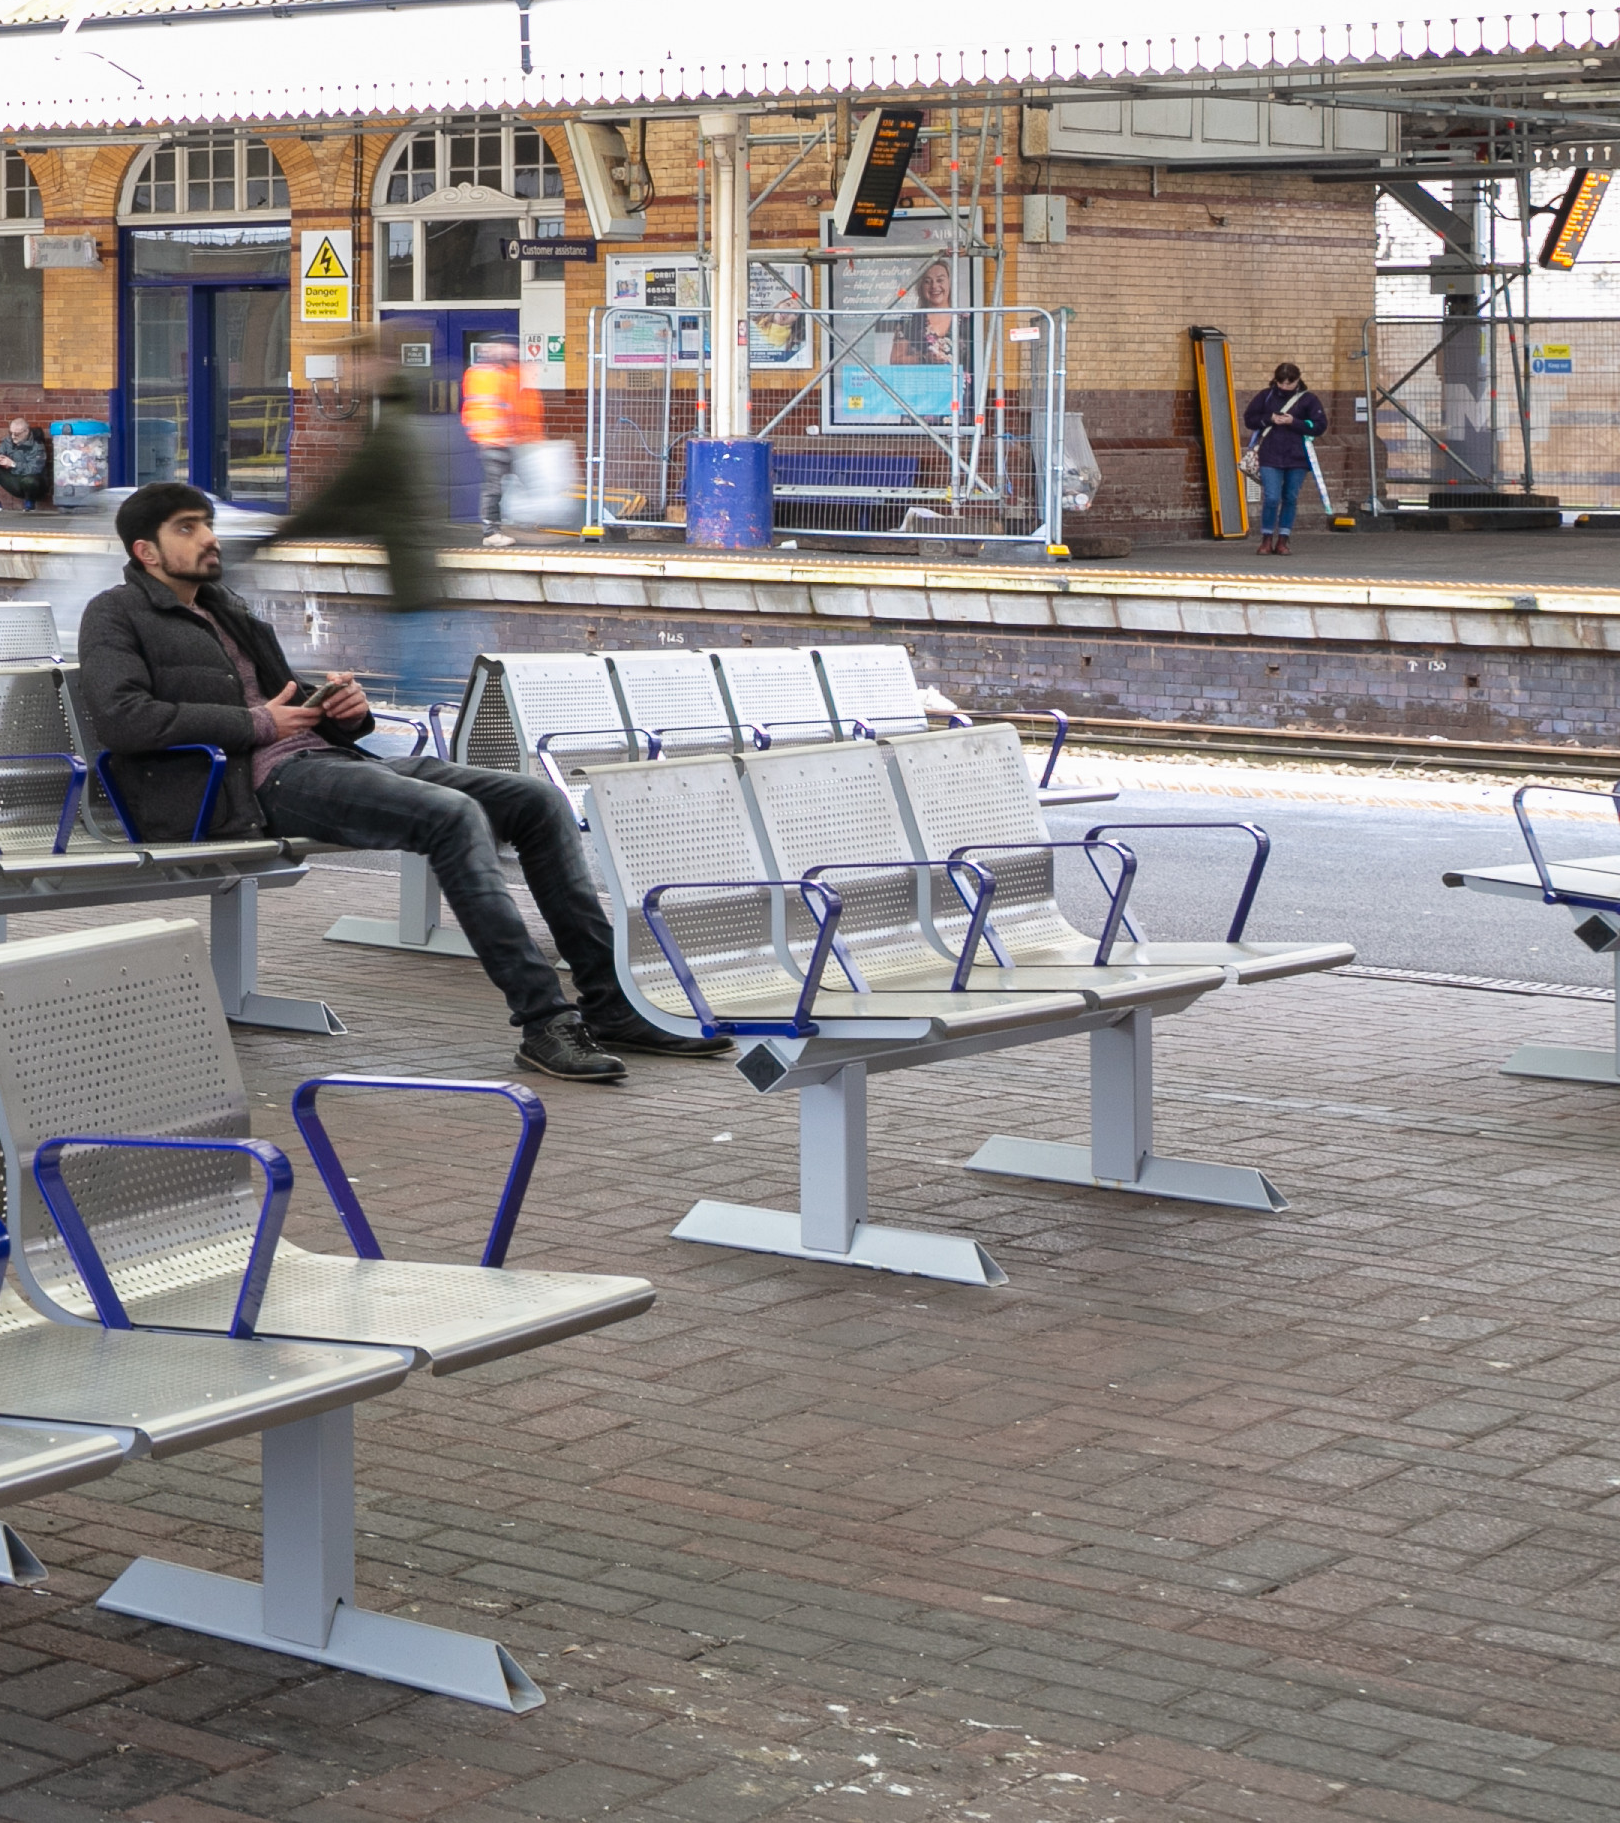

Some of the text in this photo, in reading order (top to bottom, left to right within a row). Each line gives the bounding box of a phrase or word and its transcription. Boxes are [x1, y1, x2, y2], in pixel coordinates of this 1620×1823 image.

[522, 244, 587, 256] Customer assistance
[881, 267, 912, 276] culture
[305, 287, 338, 296] Danger
